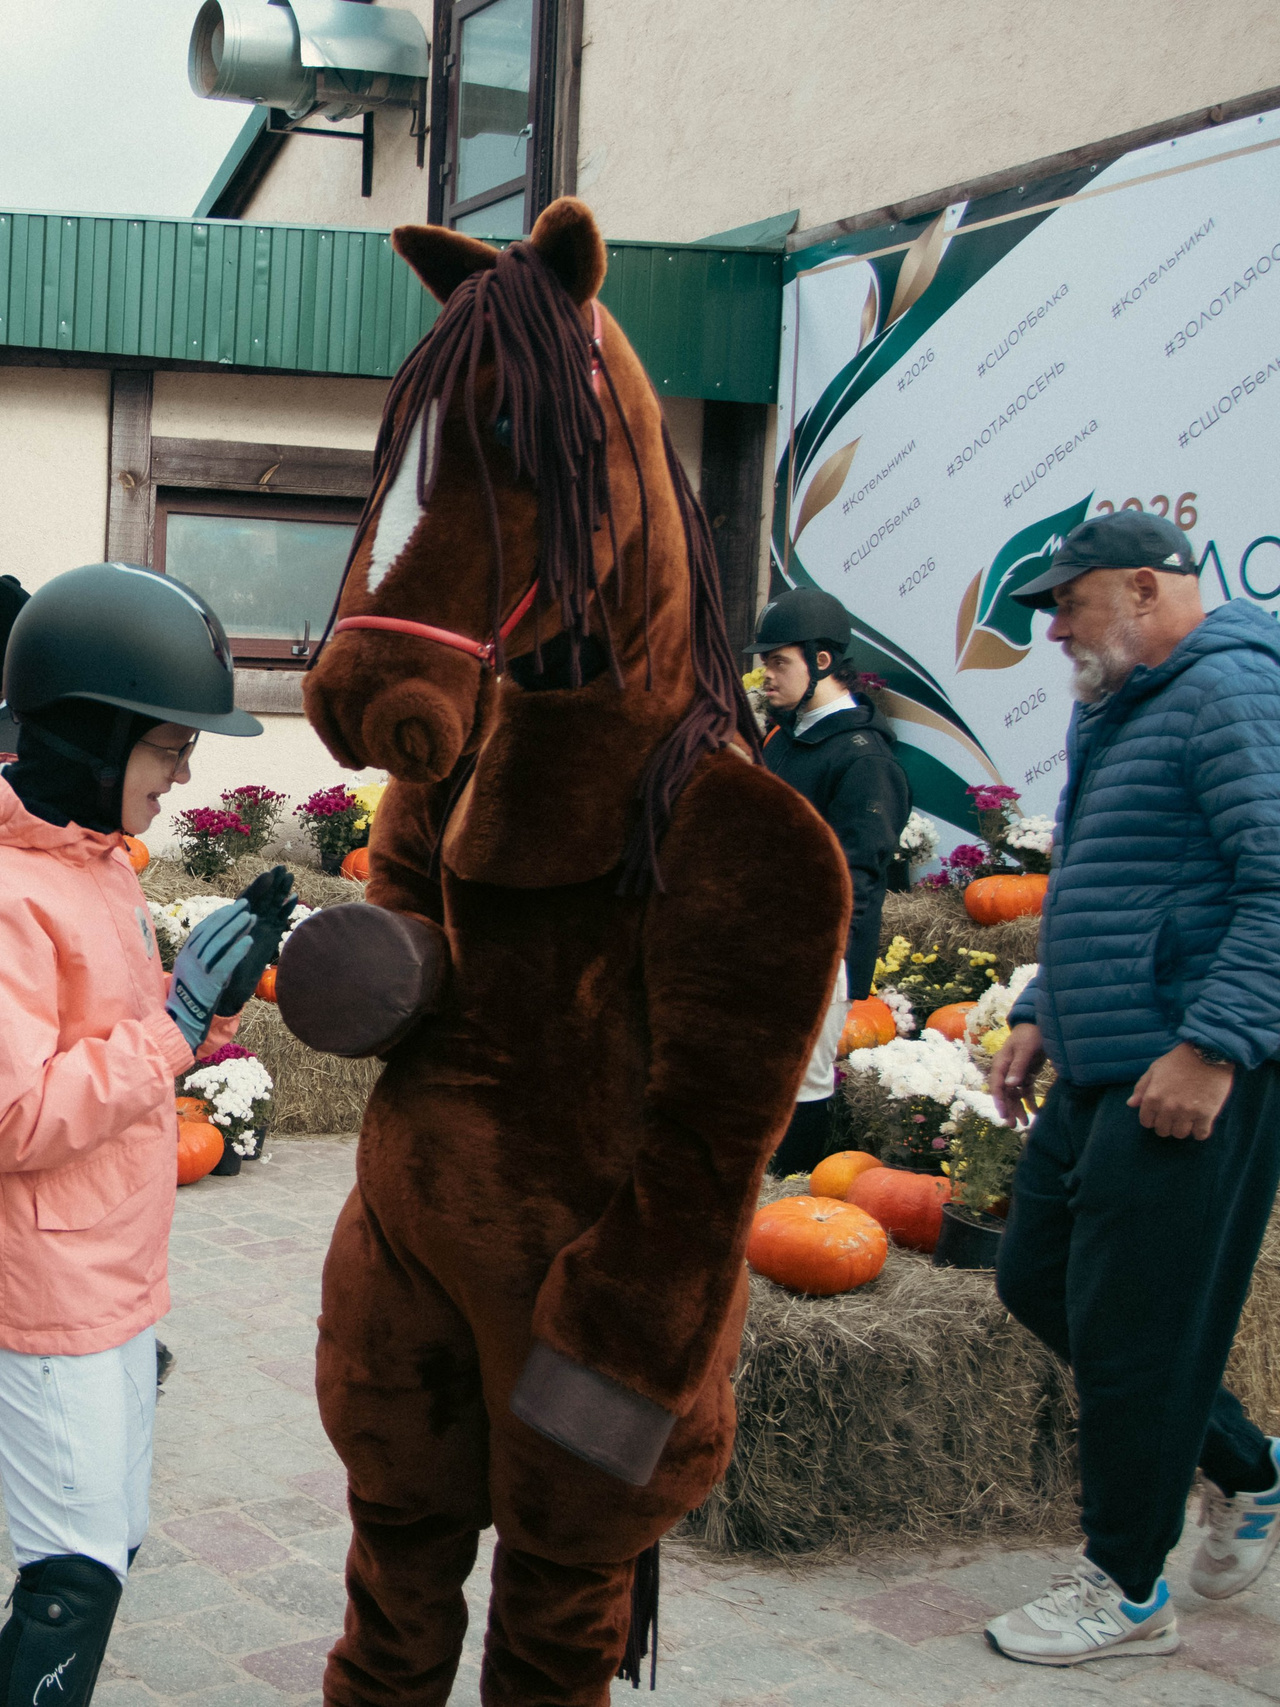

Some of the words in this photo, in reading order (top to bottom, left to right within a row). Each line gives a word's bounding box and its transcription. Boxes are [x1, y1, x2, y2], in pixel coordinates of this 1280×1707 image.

[1111, 217, 1215, 320] #Котельники
[977, 283, 1069, 378] #СШОРБелка
[897, 348, 935, 392] #2026
[946, 361, 1065, 478] #ЗОЛОТАЯОСЕНЬ
[842, 439, 917, 515] #Котельники
[1003, 419, 1098, 508] #СШОРБелка
[843, 497, 921, 573] #СШОРБелка
[898, 556, 936, 598] #2026
[1004, 687, 1046, 728] #2026
[176, 984, 207, 1019] STEEDS
